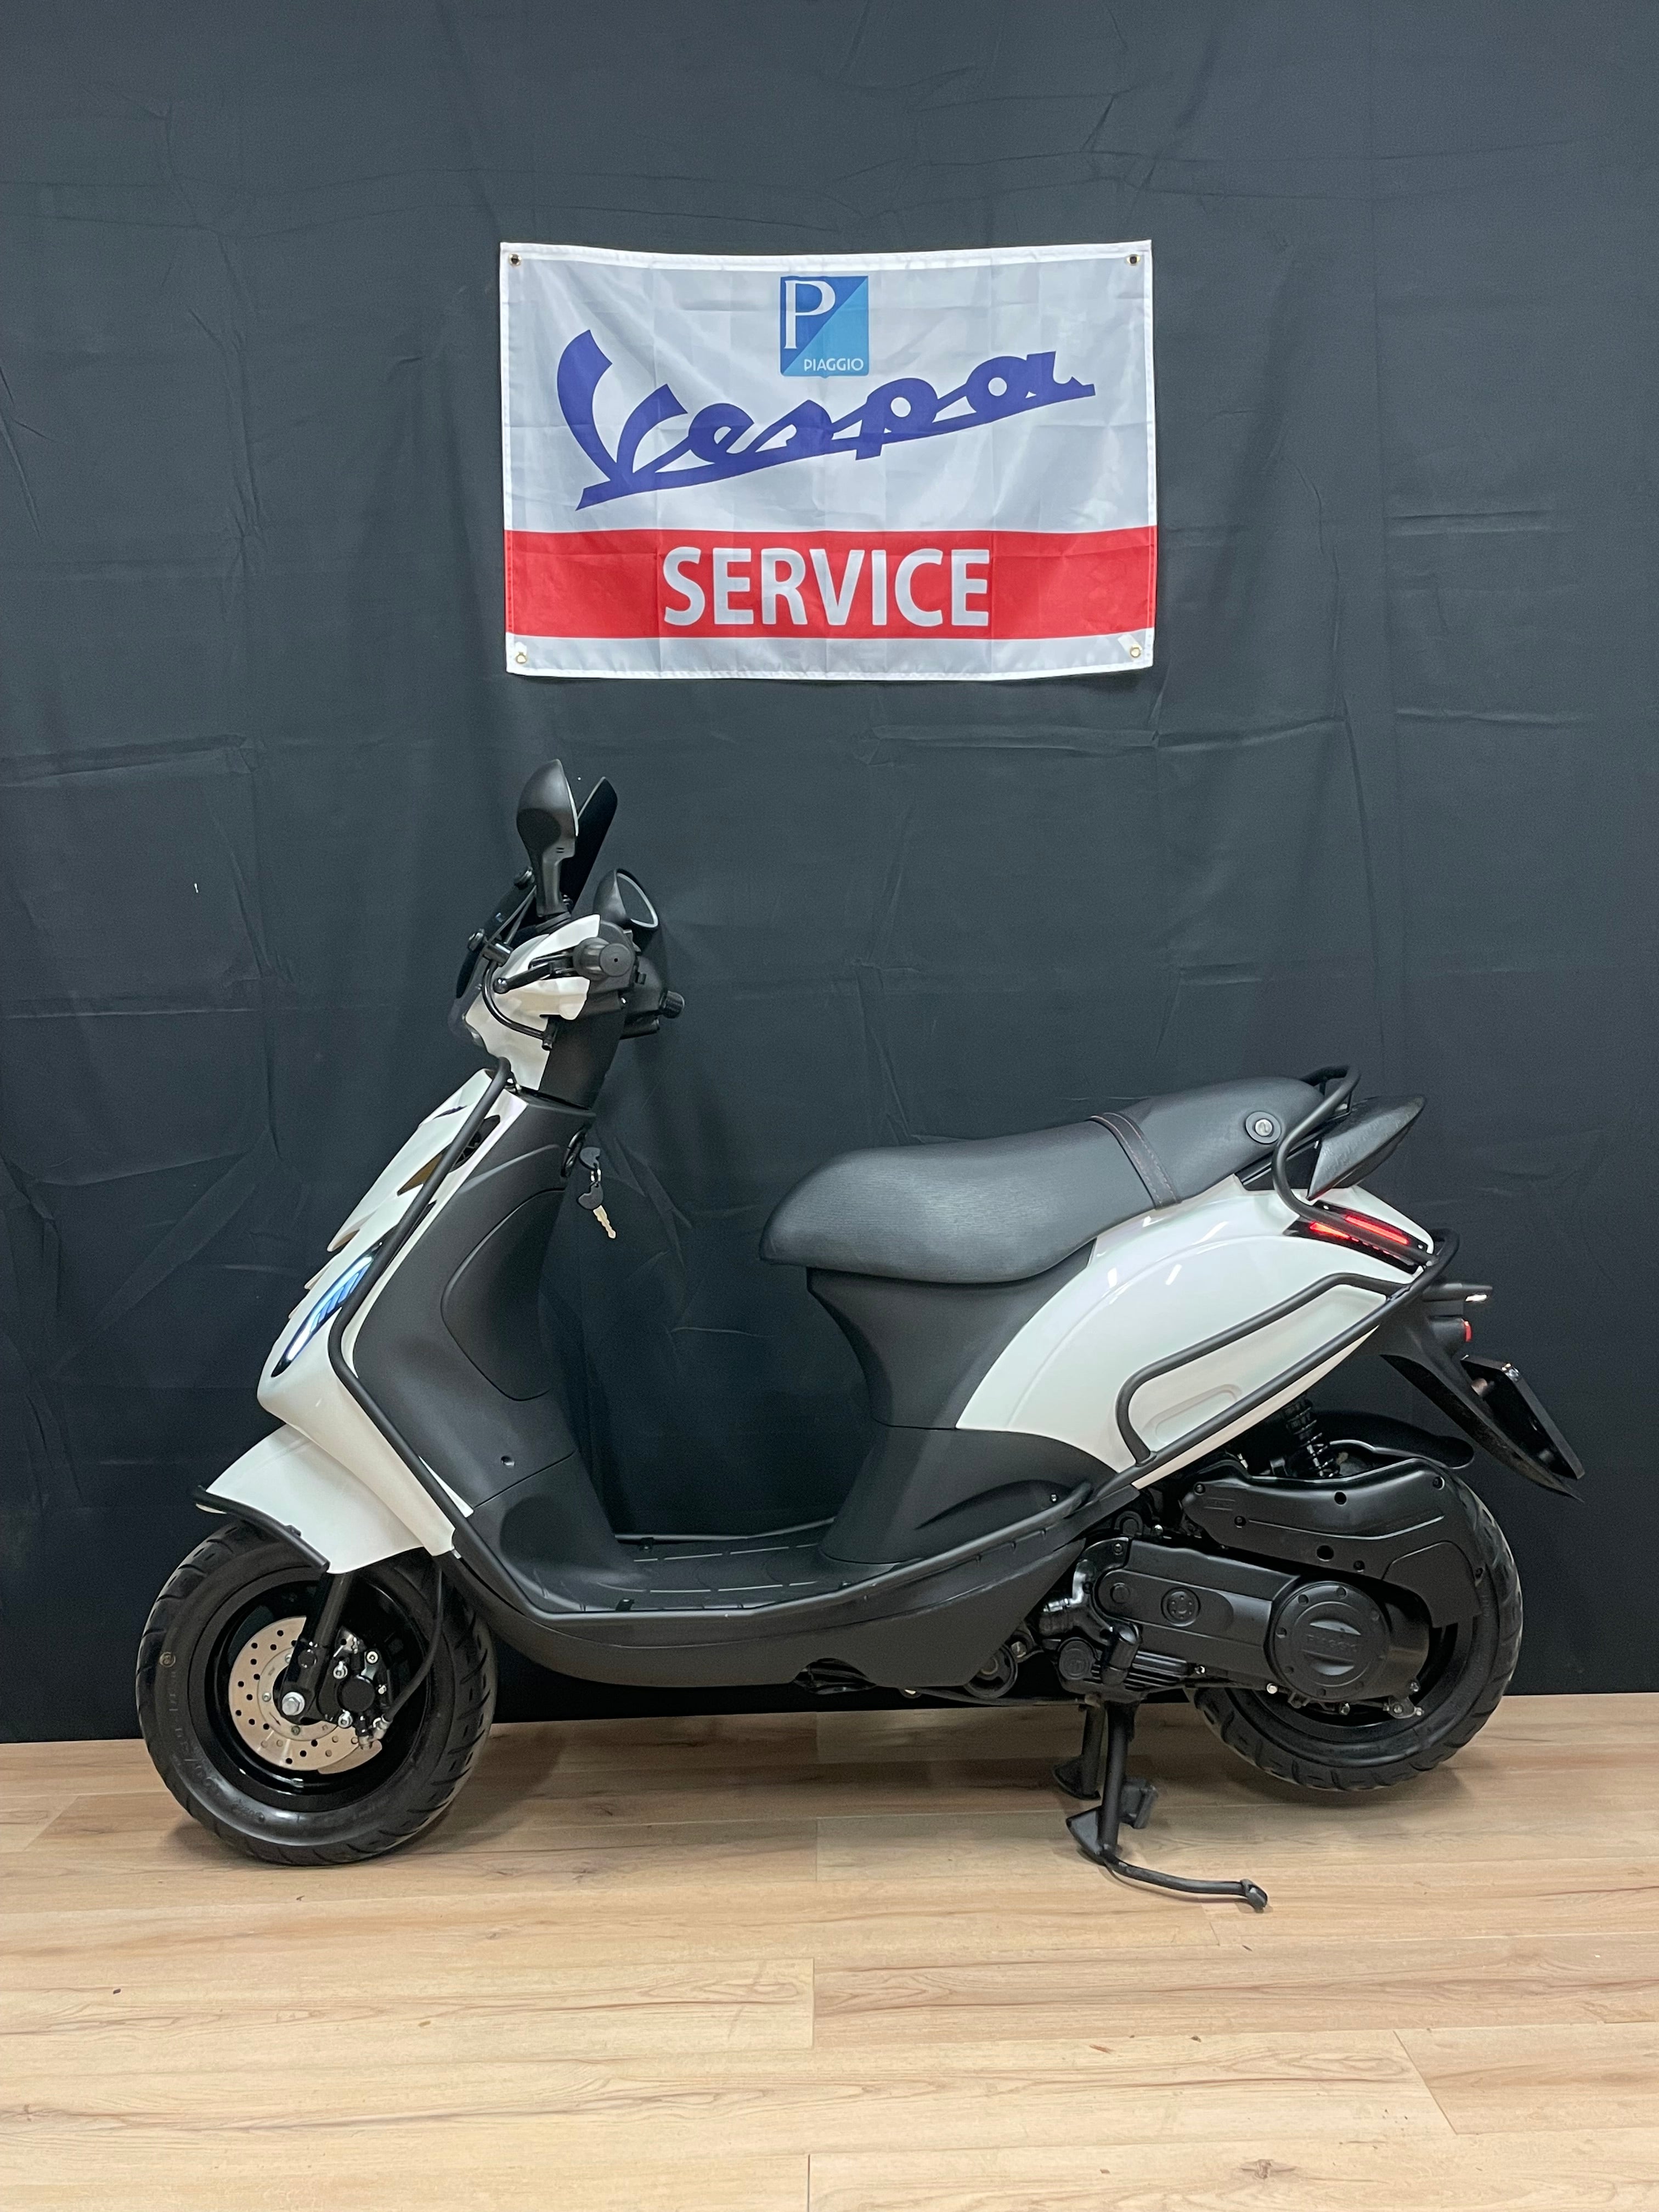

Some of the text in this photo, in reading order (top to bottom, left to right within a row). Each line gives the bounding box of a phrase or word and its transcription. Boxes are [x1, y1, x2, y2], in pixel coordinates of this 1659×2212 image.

[784, 280, 836, 349] P
[804, 358, 864, 372] PIAGGIO
[556, 329, 1096, 511] Vespa
[663, 546, 990, 627] SERVICE
